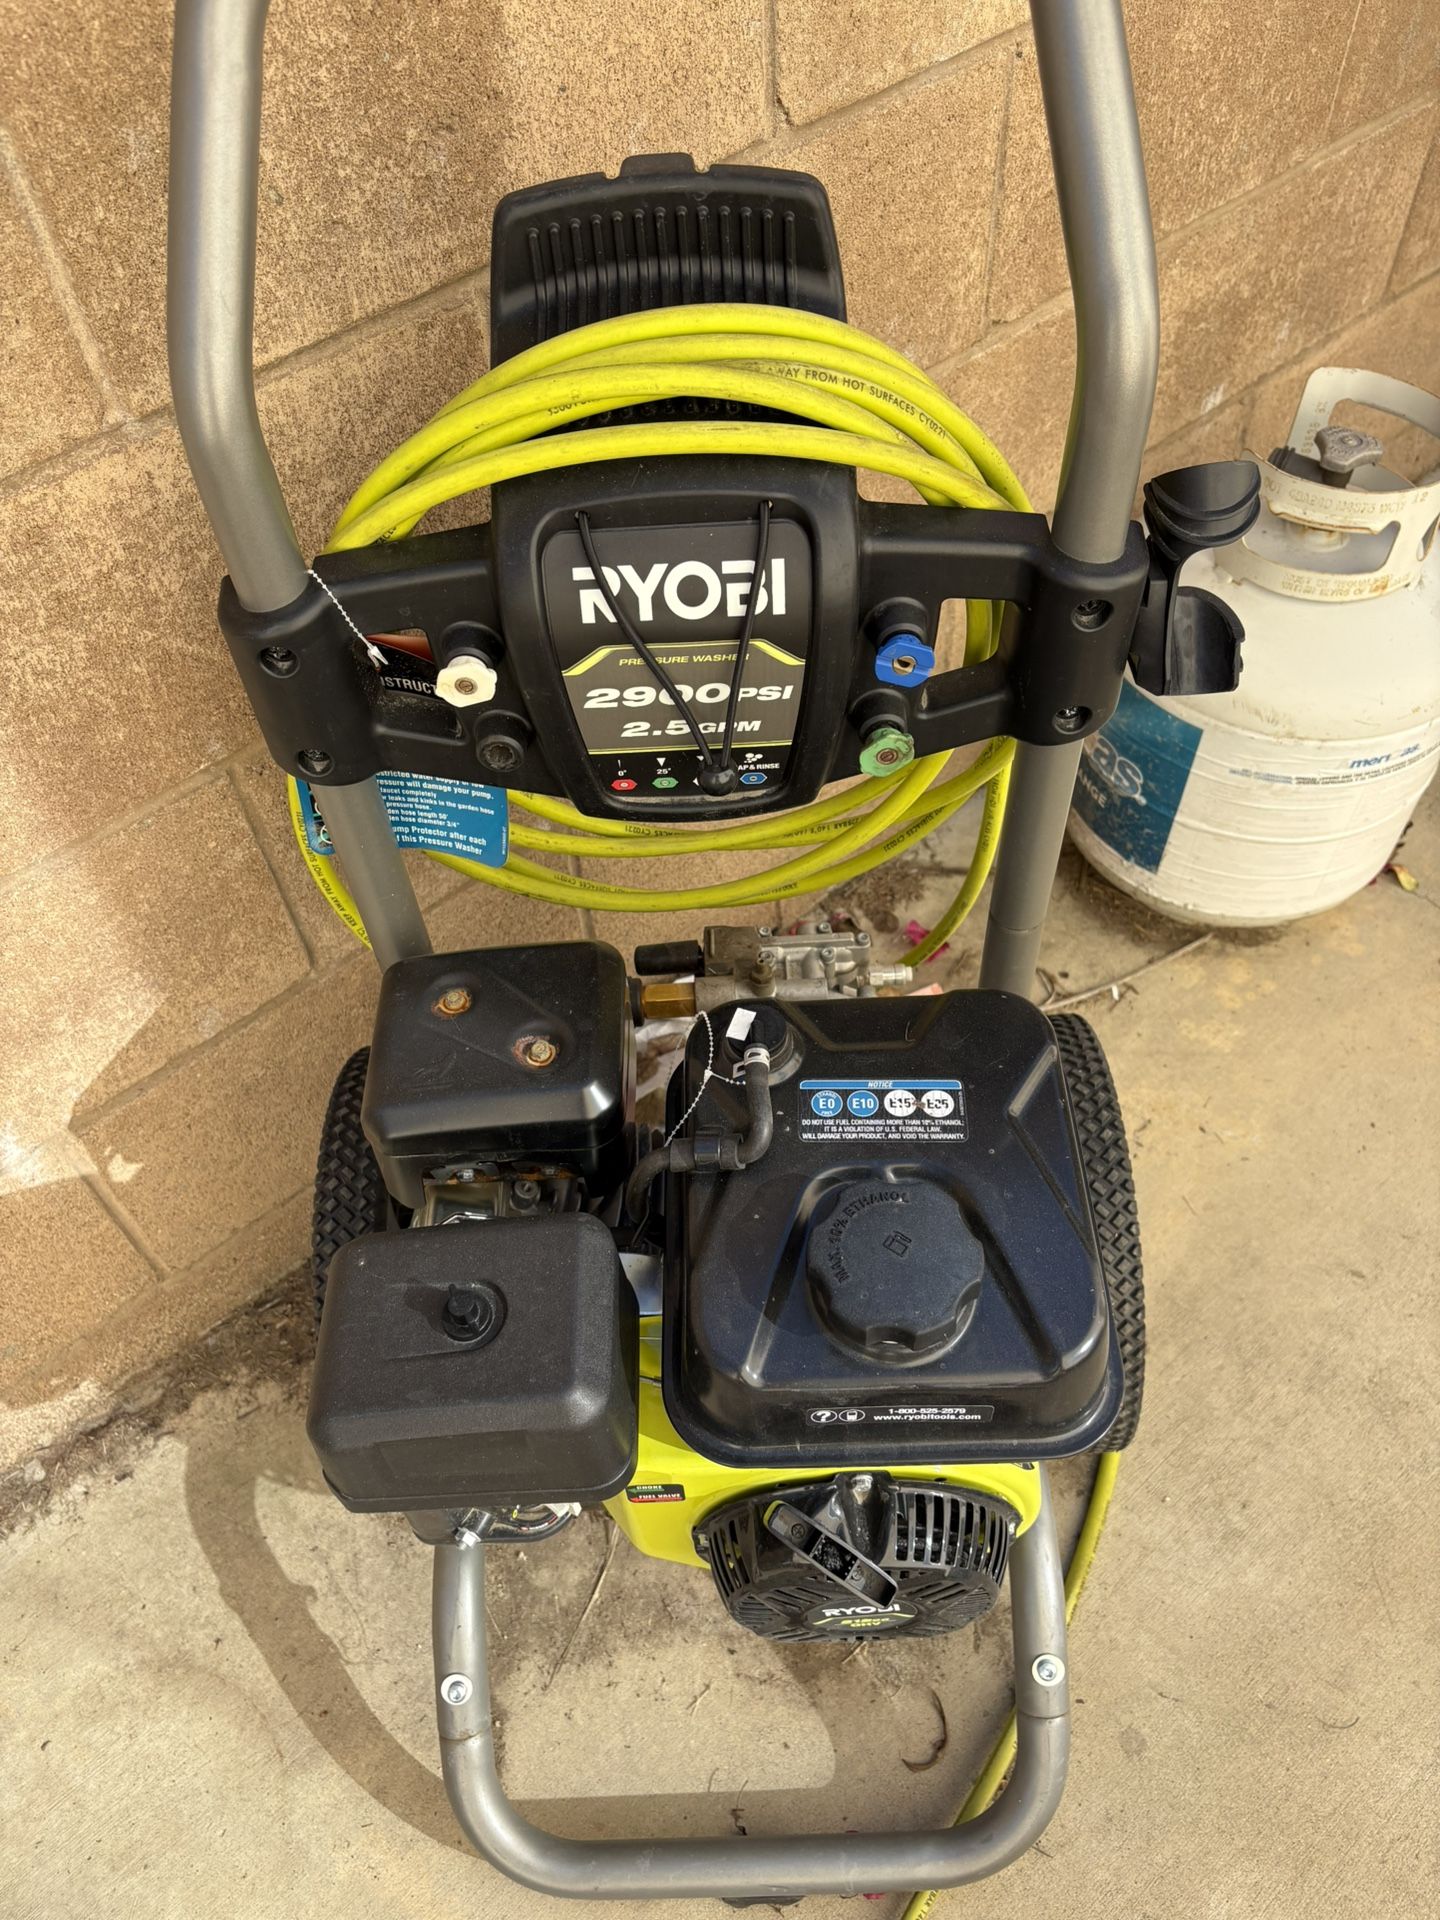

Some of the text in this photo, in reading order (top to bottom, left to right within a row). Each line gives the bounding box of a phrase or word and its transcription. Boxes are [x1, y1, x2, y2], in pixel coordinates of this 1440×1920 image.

[805, 369, 839, 385] FROM
[843, 378, 866, 392] HOT
[869, 386, 916, 416] SURFACES
[572, 558, 786, 624] RYOBI
[619, 655, 689, 667] PRESURE
[583, 682, 794, 709] 2900 PSI
[620, 719, 692, 738] 2.5
[656, 767, 671, 775] 25°
[756, 762, 780, 770] RINSE
[401, 787, 437, 799] completely
[407, 780, 421, 788] will
[422, 782, 452, 793] damage
[453, 786, 470, 795] your
[471, 790, 495, 800] pump.
[386, 801, 414, 809] pressure
[420, 797, 438, 806] kinks
[457, 804, 479, 812] garden
[480, 806, 495, 816] hose
[400, 809, 416, 817] hose
[417, 810, 438, 819] length
[417, 817, 446, 827] diameter
[411, 826, 447, 838] Protector
[449, 832, 467, 842] after
[469, 836, 487, 847] each
[401, 835, 418, 843] this
[419, 835, 454, 848] Pressure
[455, 841, 483, 856] Washer
[320, 879, 334, 898] FROM
[868, 1081, 893, 1089] NOTICE
[819, 1098, 835, 1109] E0
[852, 1098, 875, 1109] E10
[802, 1119, 811, 1127] DO
[812, 1119, 823, 1127] NOT
[824, 1119, 835, 1127] USE
[835, 1119, 850, 1127] FUEL
[851, 1119, 886, 1127] CONTAINING
[886, 1119, 904, 1127] MORE
[905, 1119, 921, 1127] THAN
[873, 1413, 982, 1421] www.ryobitools.com
